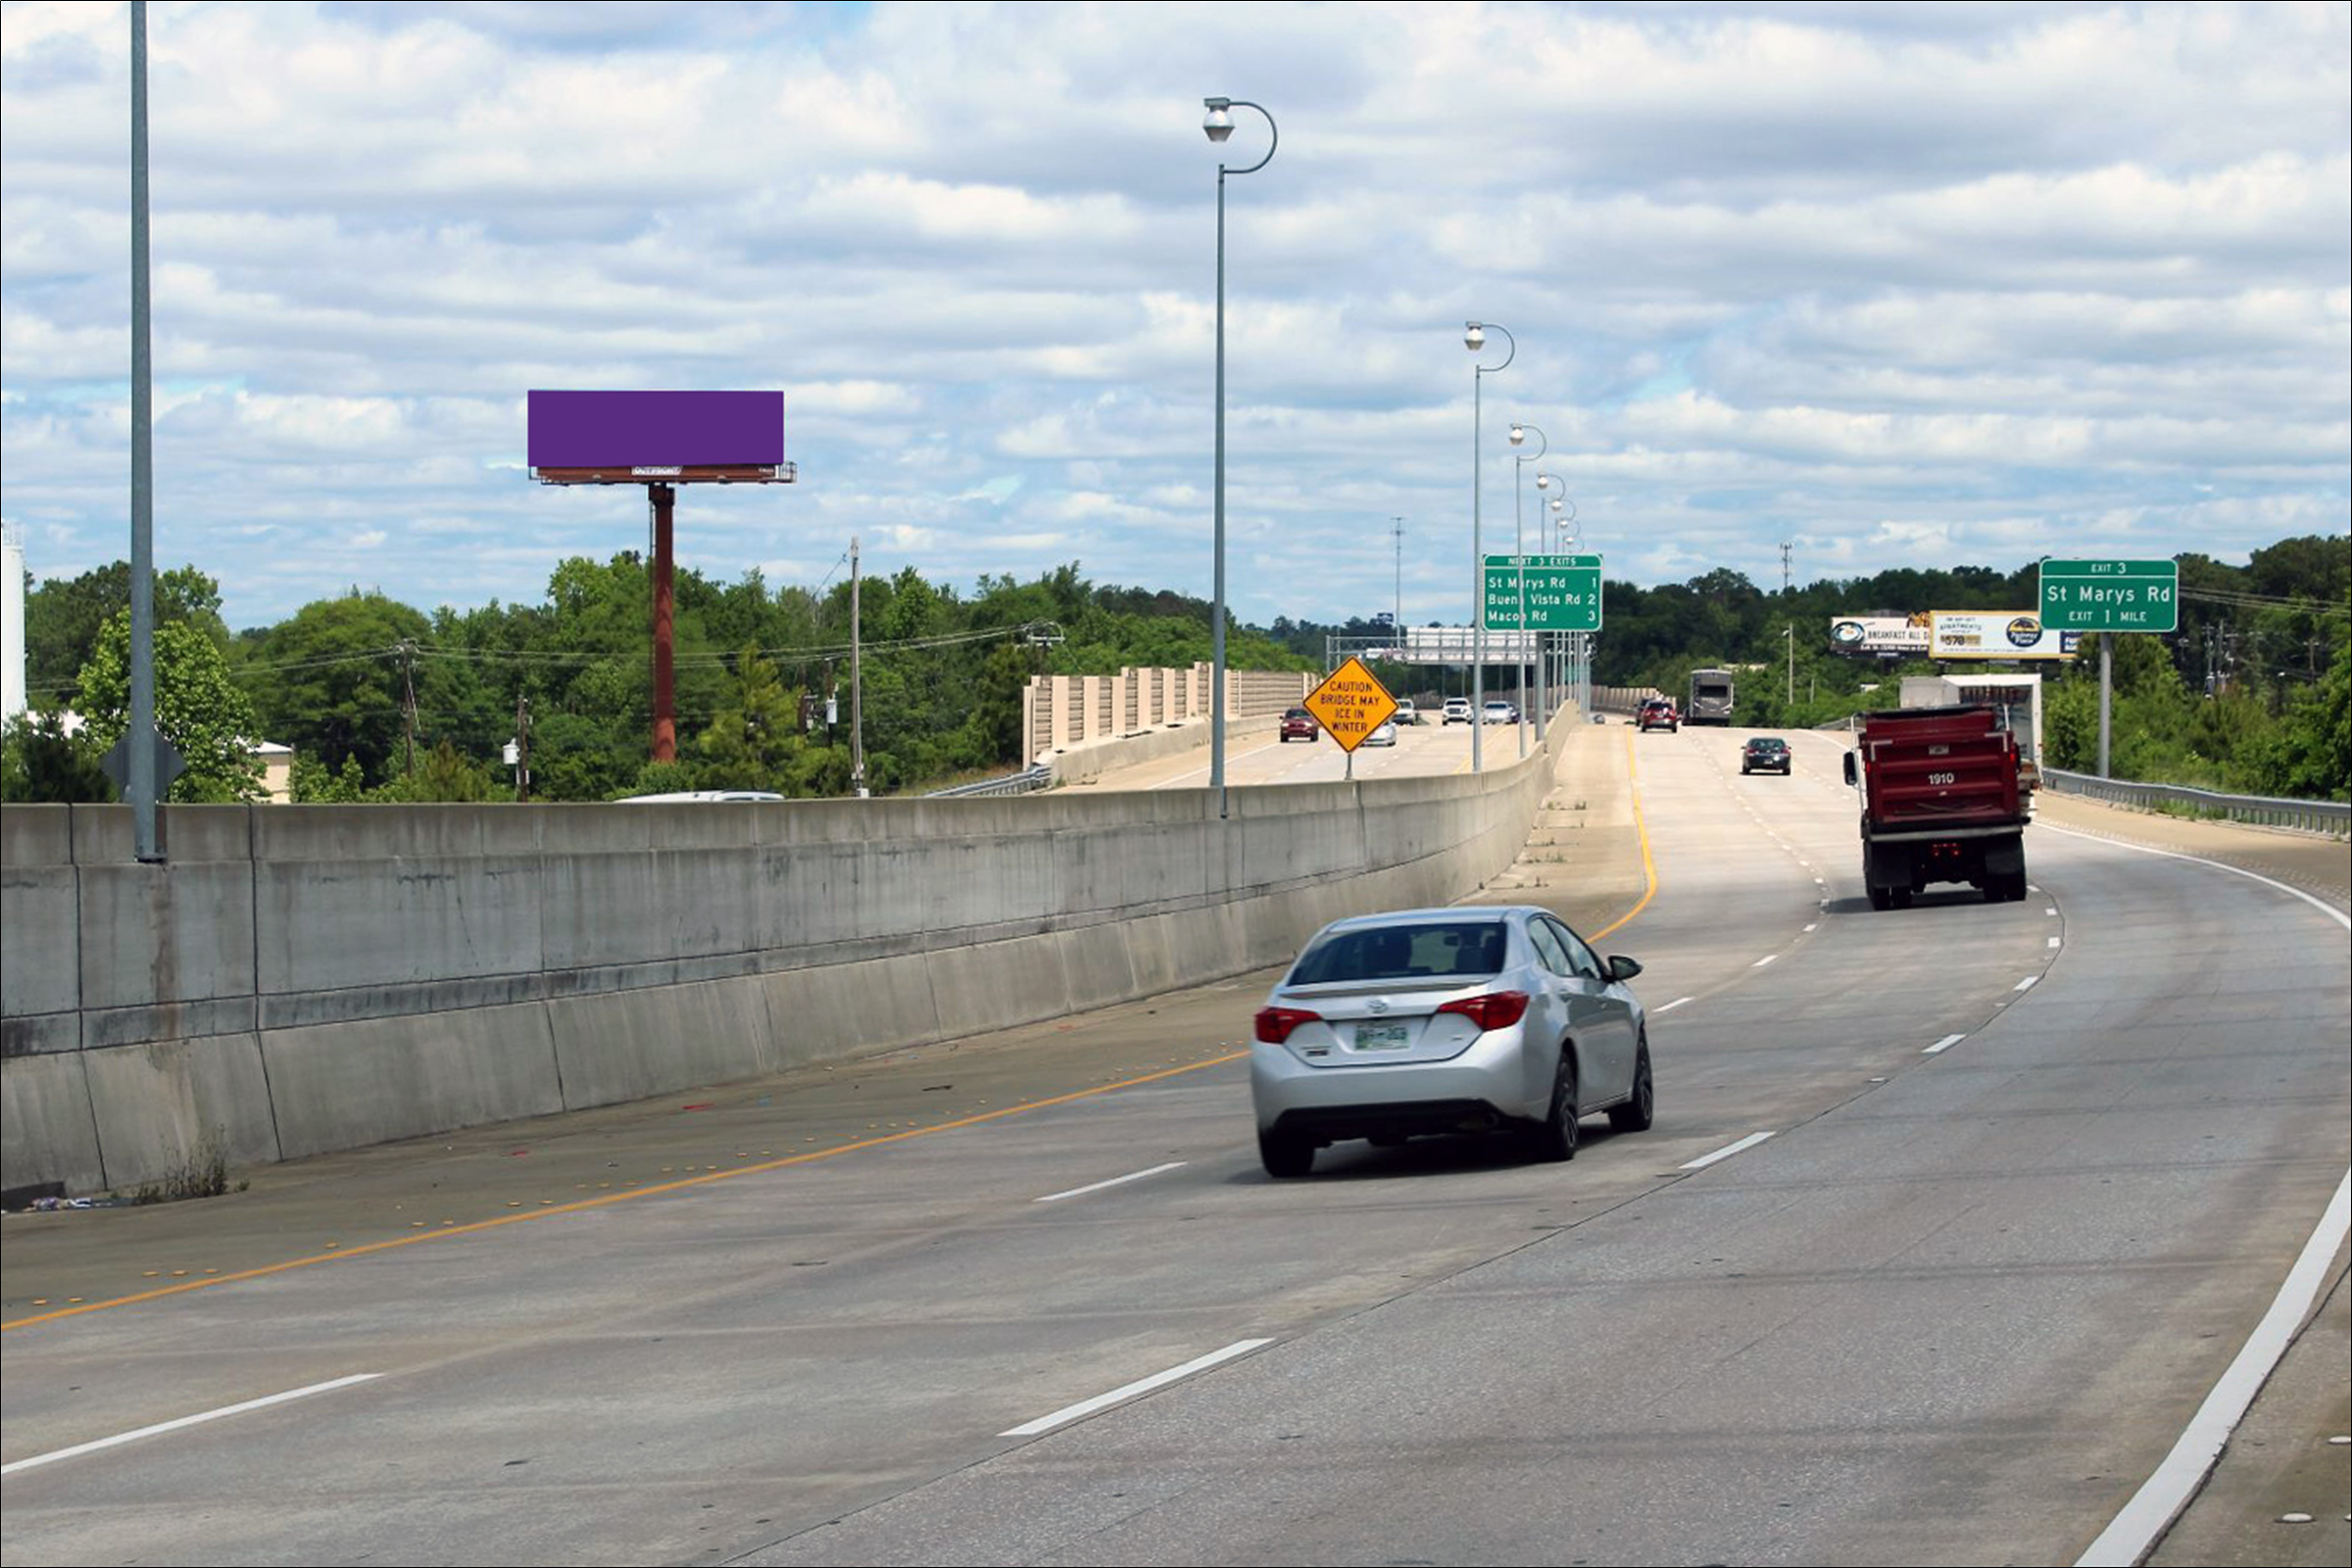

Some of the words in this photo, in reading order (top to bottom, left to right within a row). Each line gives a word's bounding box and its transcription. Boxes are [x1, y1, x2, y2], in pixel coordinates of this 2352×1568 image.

[2091, 564, 2112, 573] EXIT
[2118, 563, 2127, 574] 3
[1489, 576, 1502, 588] St
[1507, 576, 1544, 591] Mrys
[1550, 576, 1566, 588] Rd
[1592, 577, 1596, 588] 1
[1489, 593, 1524, 605] Buen
[1531, 593, 1560, 605] Vista
[1565, 594, 1581, 605] Rd
[1588, 594, 1596, 605] 2
[2047, 585, 2067, 602] St
[2080, 586, 2135, 606] Marys
[2147, 586, 2171, 603] Rd
[1532, 611, 1547, 621] Rd
[1588, 612, 1596, 621] 3
[2069, 611, 2093, 621] EXIT
[2105, 610, 2110, 623] 1
[2120, 612, 2147, 621] MILE
[1868, 630, 1906, 639] BREAKFAST
[1329, 681, 1372, 692] CAUTION
[1320, 694, 1356, 706] BRIDGE
[1359, 696, 1380, 706] MAY
[1336, 709, 1350, 718] ICE
[1354, 709, 1365, 718] IN
[1332, 722, 1368, 732] WINTER
[1928, 772, 1955, 784] 1910
